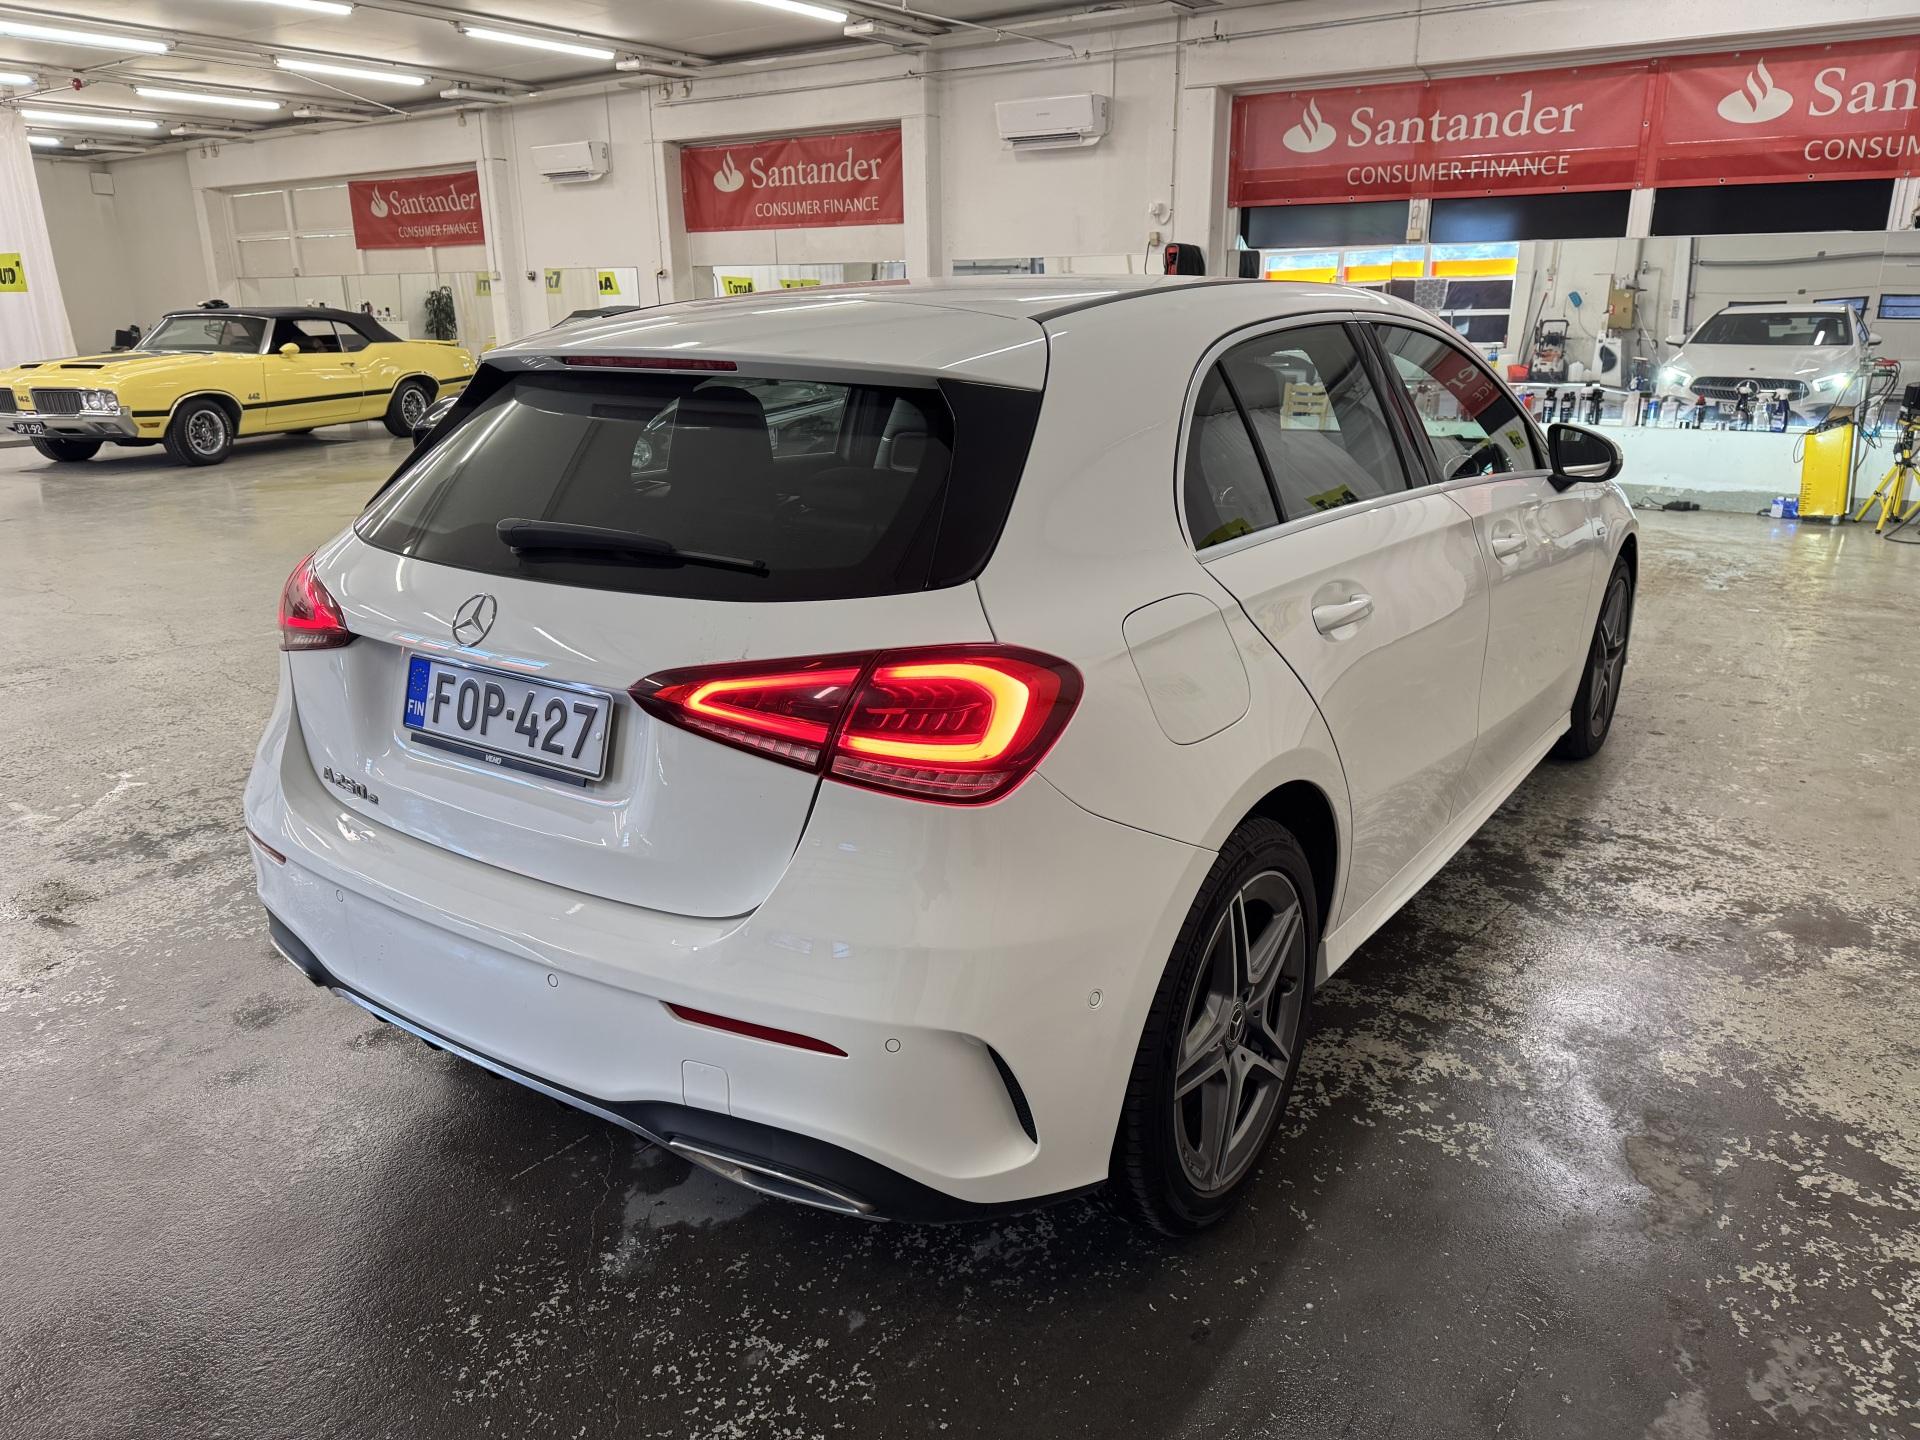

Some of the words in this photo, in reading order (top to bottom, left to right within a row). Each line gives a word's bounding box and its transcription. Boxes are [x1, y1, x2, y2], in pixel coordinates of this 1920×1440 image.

[1347, 89, 1584, 147] Santander
[750, 147, 882, 188] Santander
[1347, 161, 1463, 185] CONSUMER
[1470, 154, 1571, 178] FINANCE
[389, 184, 477, 215] Santander
[755, 199, 821, 217] CONSUMER
[824, 196, 879, 213] FINANCE
[398, 224, 441, 238] CONSUMER
[443, 222, 479, 234] FINANCE
[407, 699, 426, 717] FIN
[432, 671, 599, 759] FOP-427
